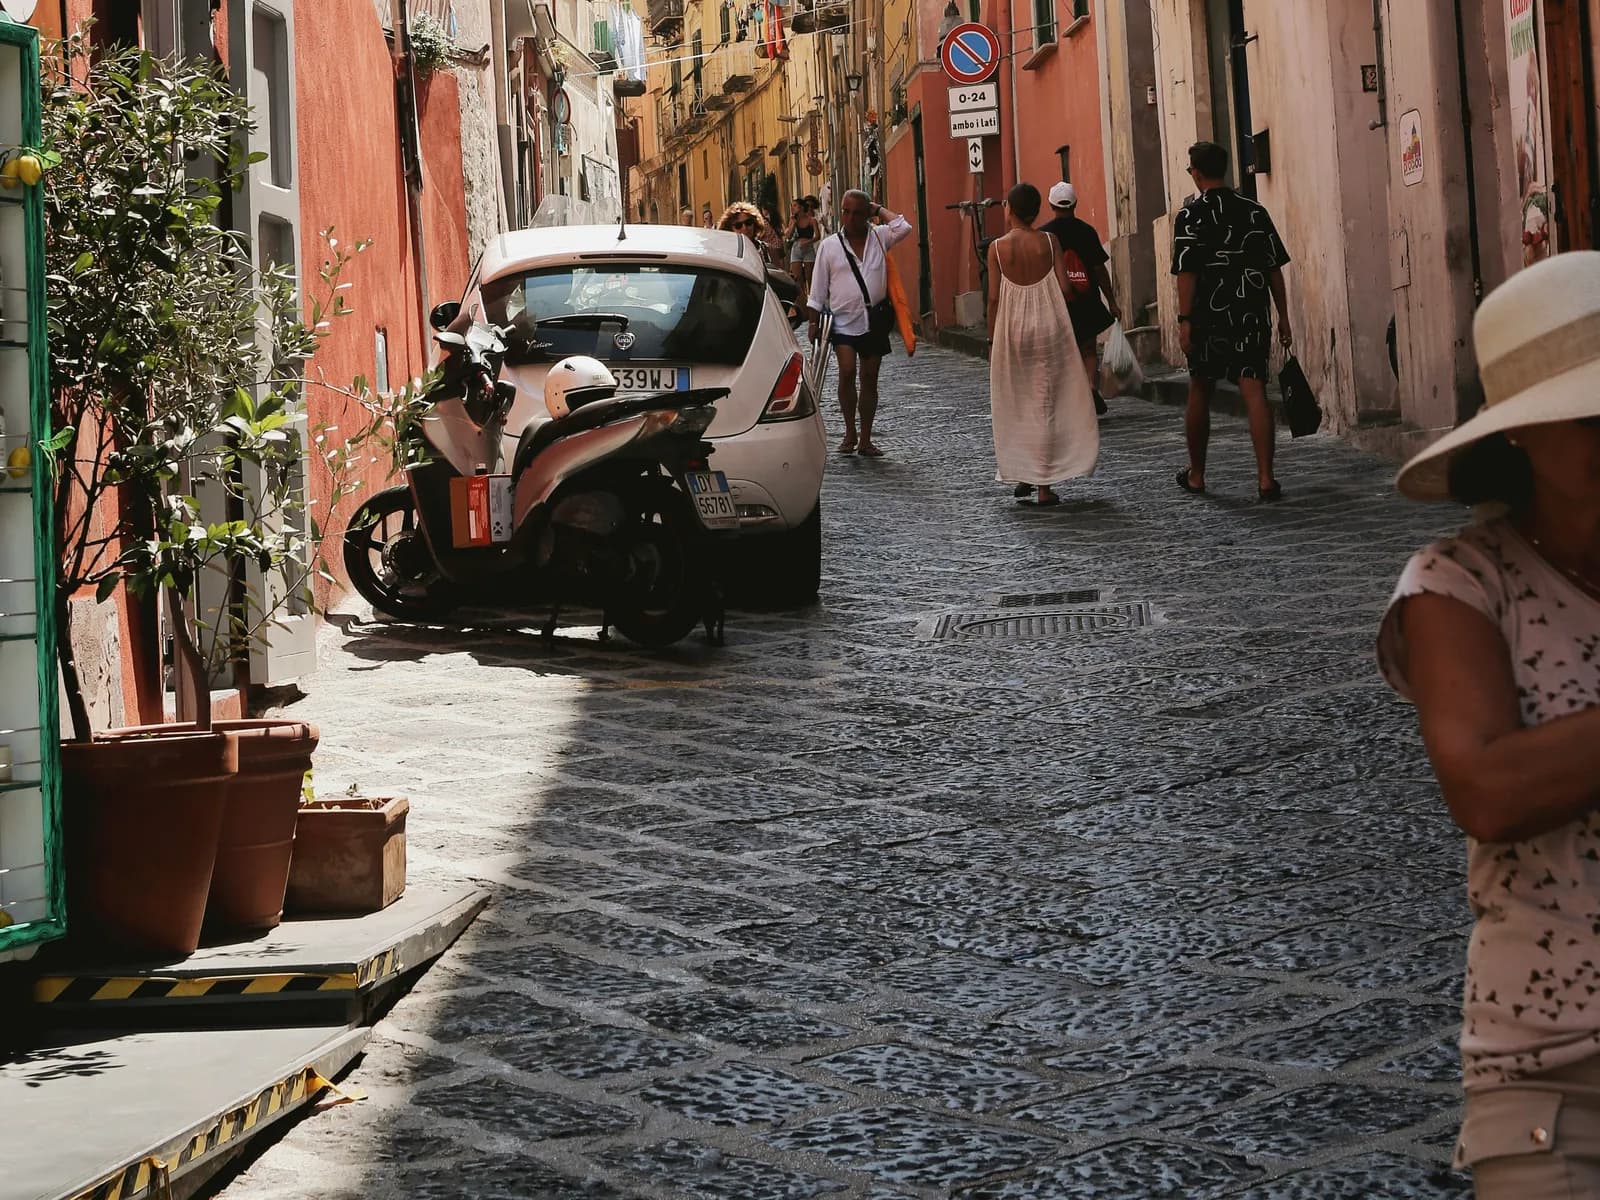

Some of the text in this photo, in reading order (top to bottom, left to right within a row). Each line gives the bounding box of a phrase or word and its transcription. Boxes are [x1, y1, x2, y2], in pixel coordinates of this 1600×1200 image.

[958, 91, 986, 104] 0-24
[952, 117, 997, 131] ambo i lati
[611, 369, 675, 389] 539WJ
[697, 474, 713, 492] DY
[699, 496, 732, 514] 56781
